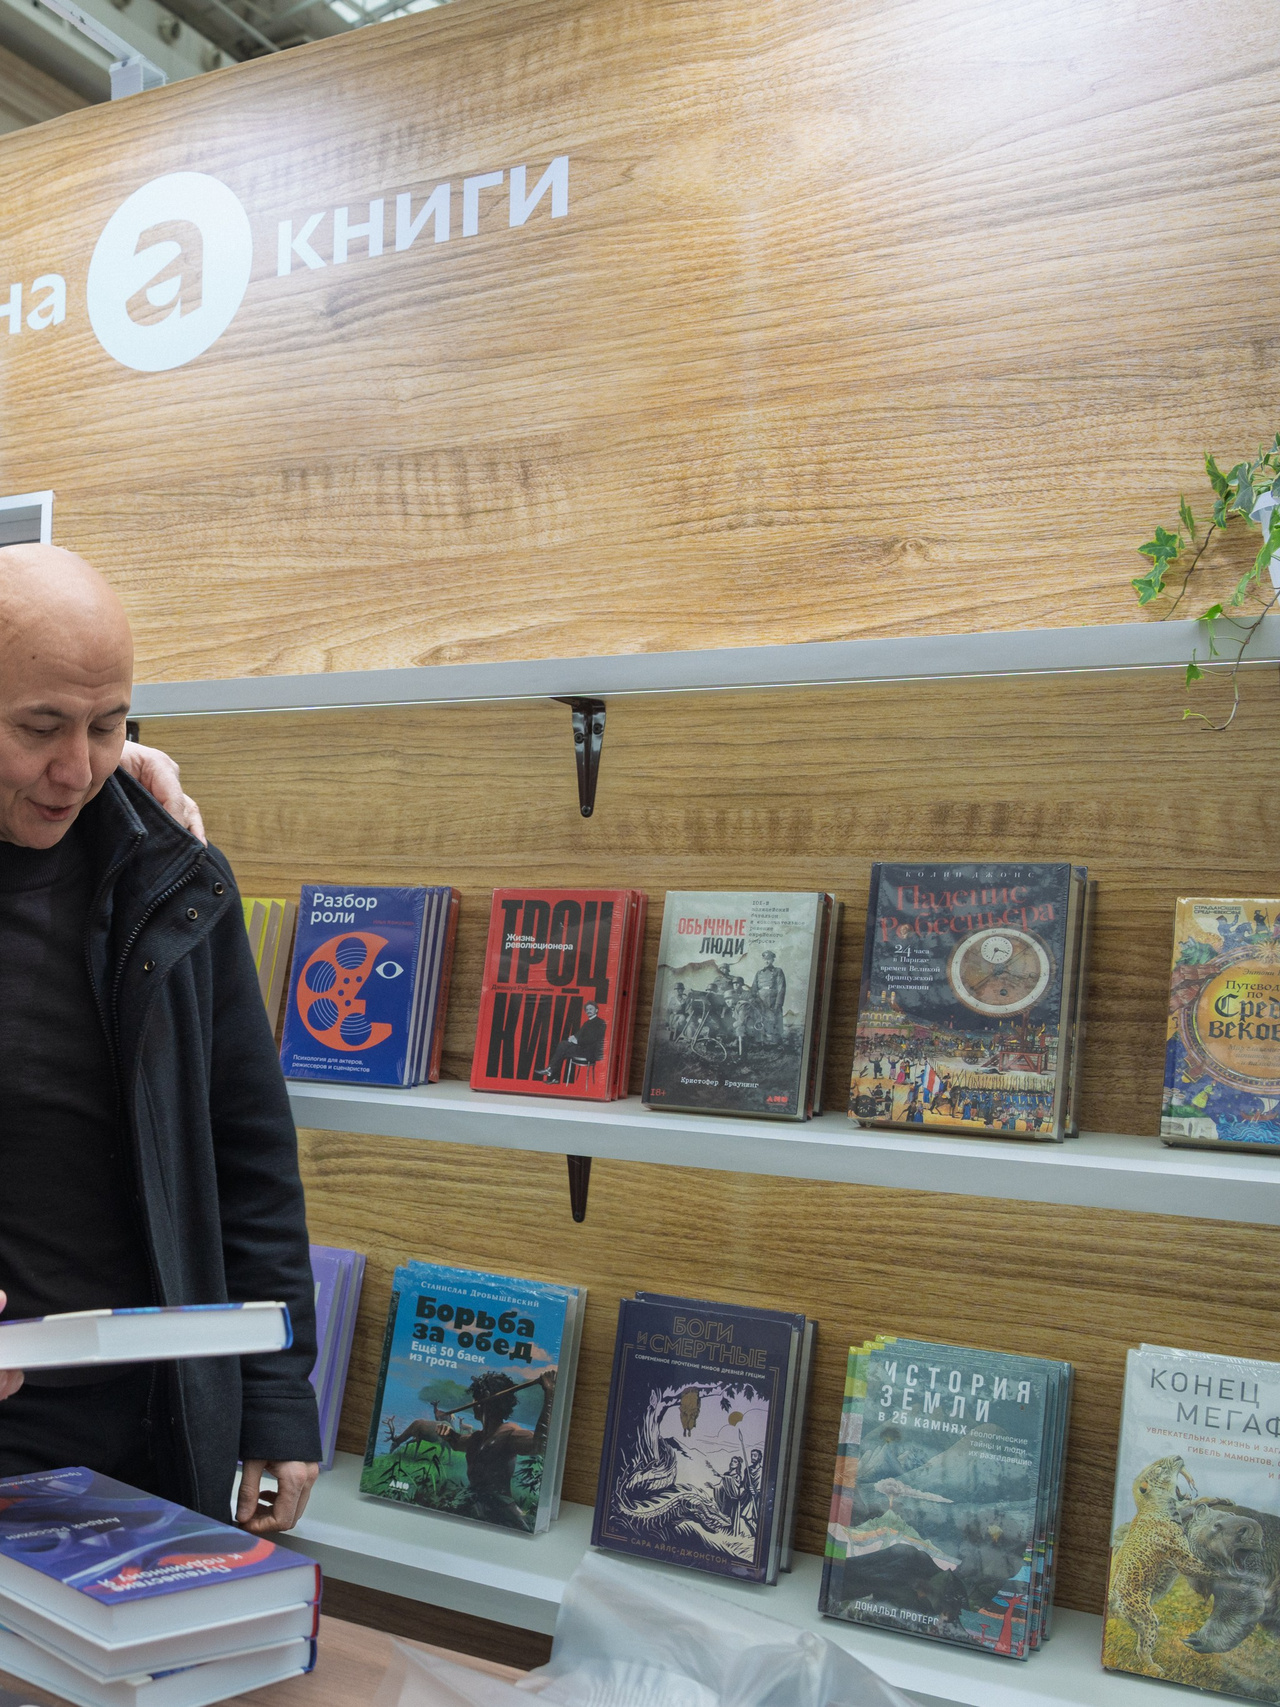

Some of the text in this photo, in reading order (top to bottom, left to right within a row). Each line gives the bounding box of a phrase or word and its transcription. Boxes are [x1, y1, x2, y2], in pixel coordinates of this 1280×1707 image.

[277, 154, 570, 277] книги
[313, 892, 378, 911] Разбор
[896, 885, 1029, 912] Падение
[310, 910, 355, 925] роли
[677, 917, 747, 937] ОБЫЧНЫЕ
[505, 941, 574, 951] революционера
[506, 933, 536, 942] Жизнь
[698, 937, 745, 958] ЛЮДИ
[496, 899, 614, 1004] ТРОЦ
[894, 944, 911, 957] 24
[1247, 991, 1263, 999] по
[293, 1054, 327, 1062] Психология
[333, 1065, 370, 1073] сценаристов
[680, 1076, 759, 1089] Кристофер Браунинг
[415, 1295, 535, 1338] Борьба
[672, 1316, 734, 1343] БОГИ
[410, 1340, 486, 1365] Ещё 50 баек
[412, 1322, 533, 1363] за обед
[649, 1334, 768, 1370] СМЕРТНЫЕ
[409, 1351, 458, 1369] из грота
[634, 1353, 766, 1380] СОВРЕМЕННОЕ ПРОЧТЕНИЕ МИФОВ ДРЕВНЕЙ ГРЕЦИИ
[883, 1360, 1031, 1405] ИСТОРИЯ
[1150, 1368, 1260, 1409] КОНЕЦ
[880, 1384, 990, 1423] ЗЕМЛИ
[878, 1410, 968, 1435] в 25 камнях
[970, 1428, 1028, 1445] Геологические
[970, 1440, 995, 1450] тайны
[1146, 1426, 1217, 1444] УВЛЕКАТЕЛЬНАЯ
[1219, 1439, 1251, 1450] ЖИЗНЬ
[1253, 1443, 1260, 1451] И
[979, 1452, 1033, 1467] разгадавшие
[1187, 1446, 1221, 1457] ГИБЕЛЬ
[5, 1516, 120, 1541] Андрей Россохин
[227, 1552, 243, 1561] к
[630, 1537, 728, 1565] САРА АЙЛС-ДЖОНСТОН
[110, 1564, 232, 1592] Путешествие
[118, 1555, 226, 1582] подлинному
[854, 1600, 898, 1619] ДОНАЛЬД
